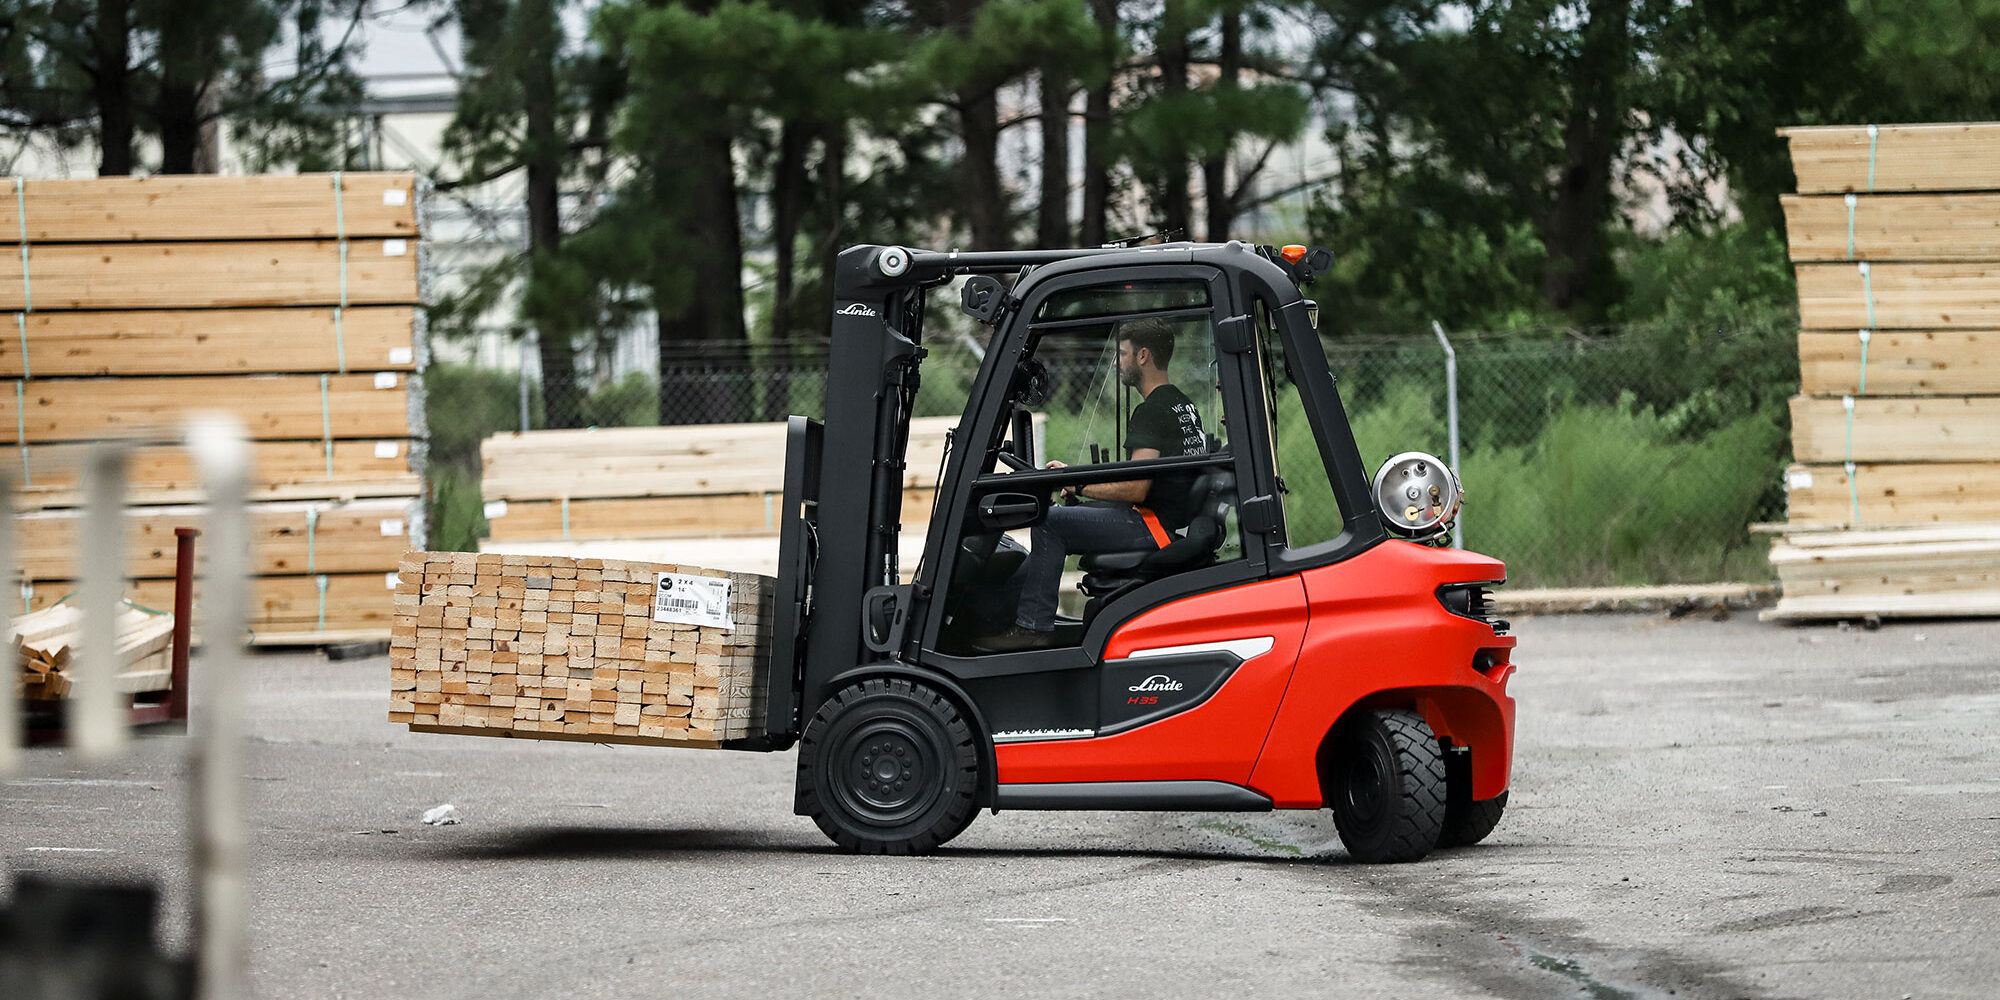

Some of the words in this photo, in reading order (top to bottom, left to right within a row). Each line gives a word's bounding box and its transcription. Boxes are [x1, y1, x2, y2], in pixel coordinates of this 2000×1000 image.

[836, 303, 876, 317] Linde
[1171, 403, 1185, 414] WE
[1181, 425, 1193, 434] THE
[1183, 435, 1203, 446] WORL
[1128, 674, 1184, 692] Linde
[1127, 696, 1138, 705] H
[1139, 696, 1159, 705] 35
